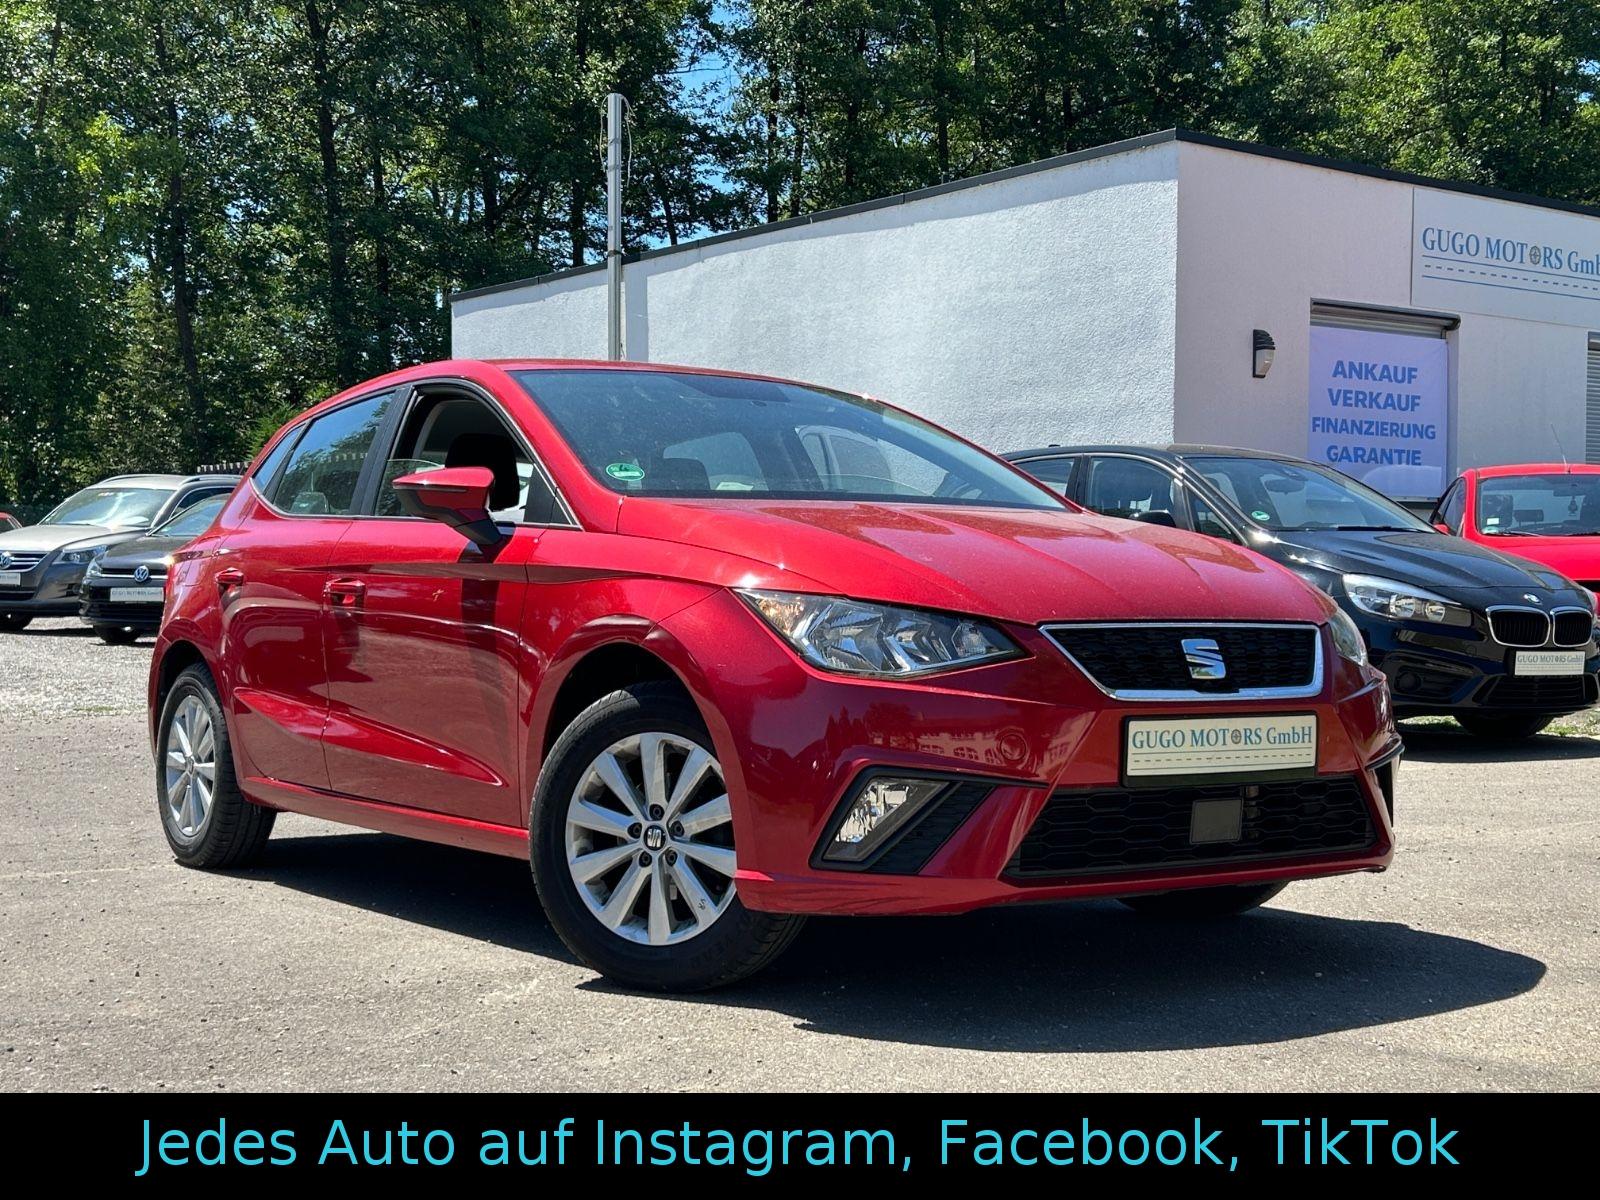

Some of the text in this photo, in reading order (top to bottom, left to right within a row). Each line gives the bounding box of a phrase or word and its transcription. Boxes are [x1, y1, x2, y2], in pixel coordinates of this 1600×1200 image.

[1422, 227, 1480, 257] GUGO
[1332, 360, 1418, 384] ANKAUF
[1327, 388, 1421, 412] VERKAUF
[1311, 416, 1436, 440] FINANZIERUNG
[1326, 445, 1422, 466] GARANTIE
[1132, 726, 1312, 749] GUGO MOTORS GmbH
